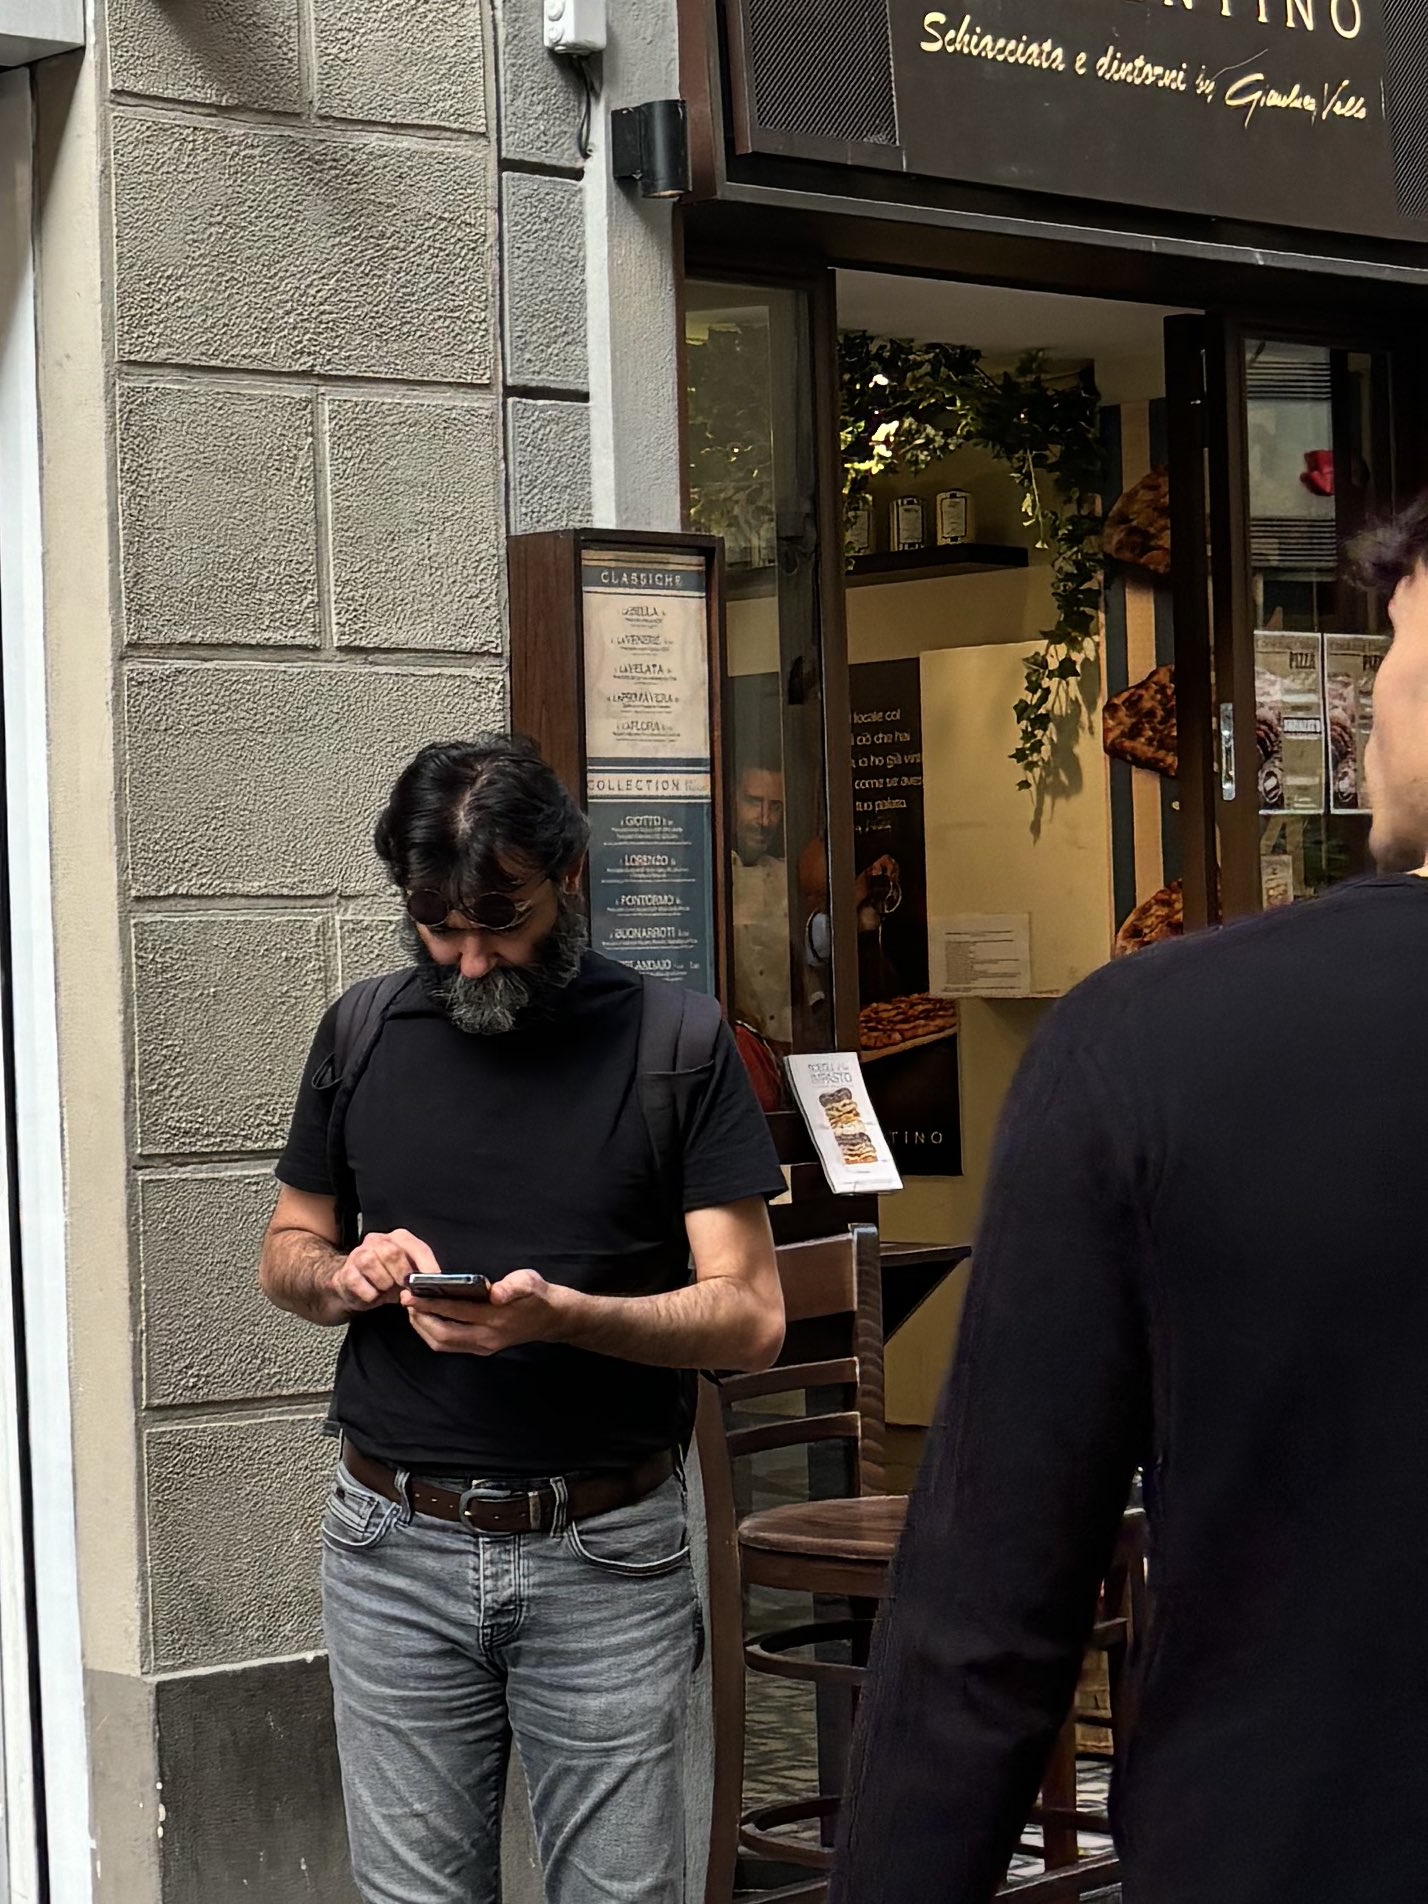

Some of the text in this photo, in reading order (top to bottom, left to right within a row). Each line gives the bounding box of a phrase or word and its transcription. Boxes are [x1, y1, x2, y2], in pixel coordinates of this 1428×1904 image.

[920, 10, 1065, 72] Schiacciata
[1075, 51, 1088, 76] e
[1095, 45, 1187, 92] dintorni
[600, 571, 683, 587] CLASSICHE
[1289, 651, 1316, 670] PIZZA
[587, 779, 680, 792] COLLECTION
